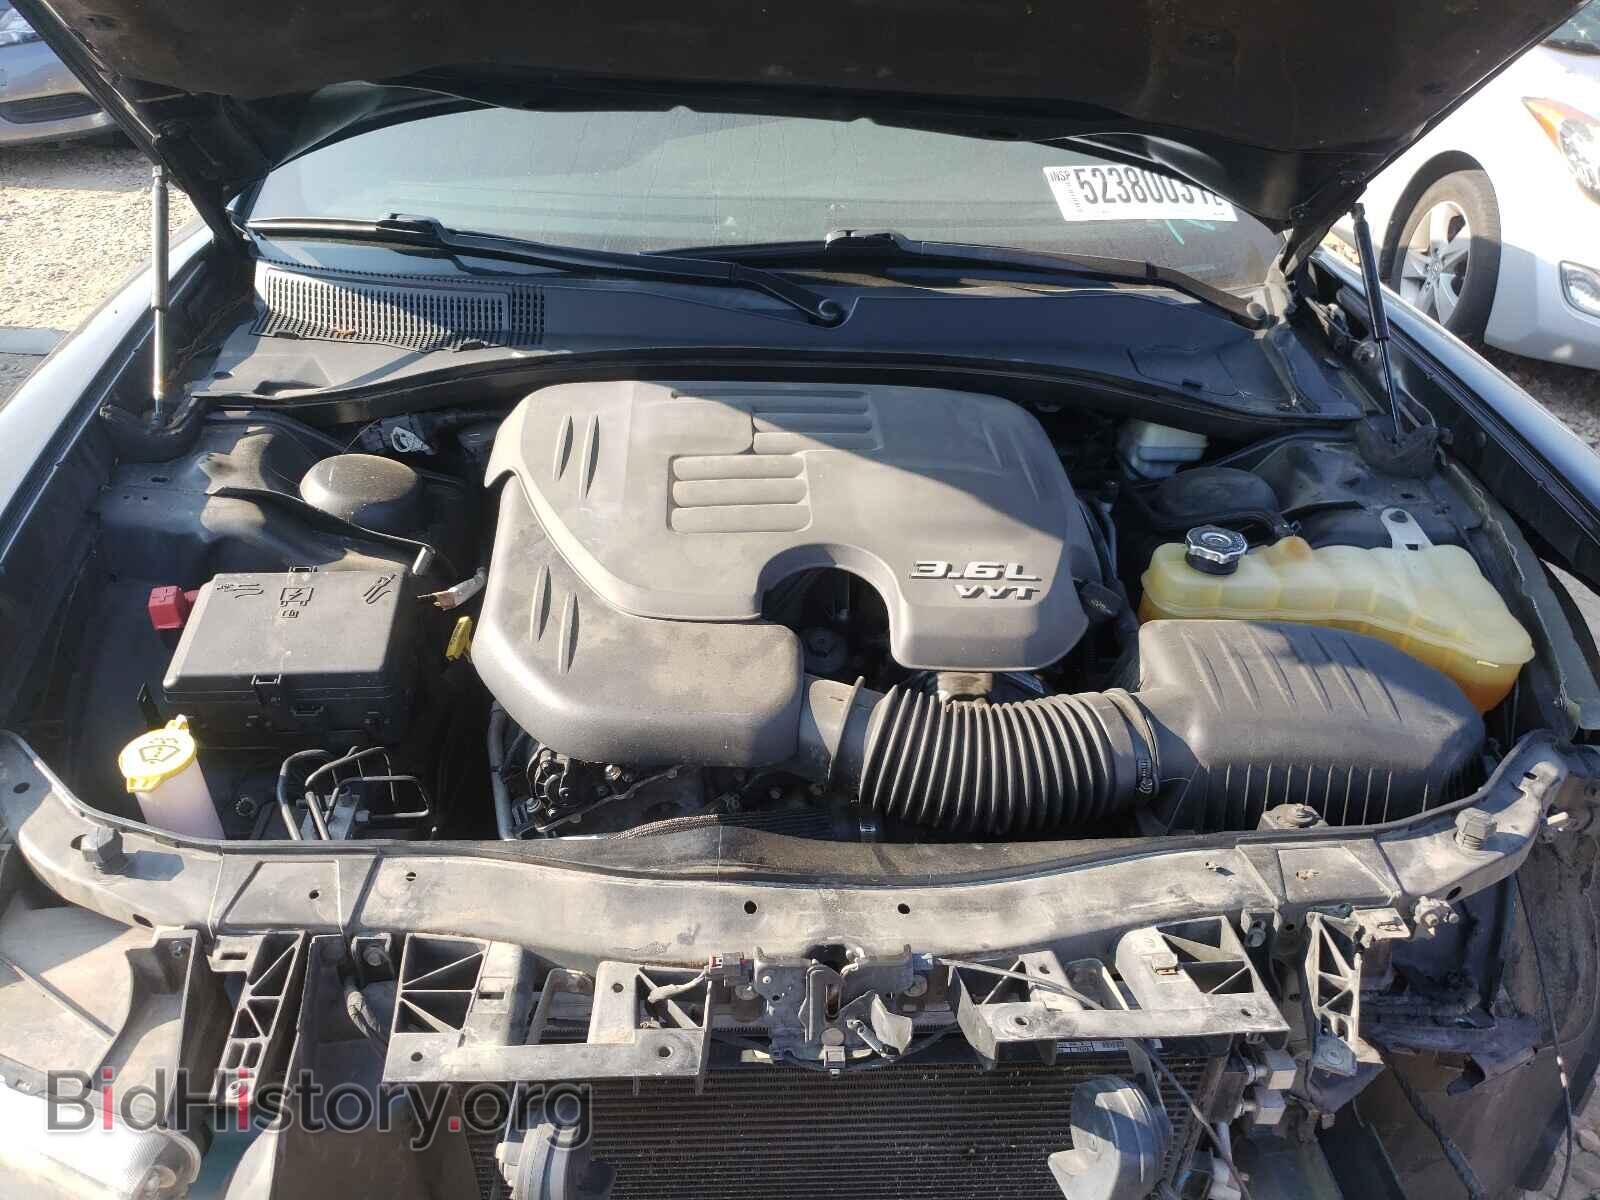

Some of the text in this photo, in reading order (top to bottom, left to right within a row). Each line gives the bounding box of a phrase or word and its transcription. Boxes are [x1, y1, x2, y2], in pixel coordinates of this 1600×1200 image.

[1050, 169, 1071, 183] INSP
[910, 560, 1041, 582] 3.6L
[954, 584, 1040, 600] VVT
